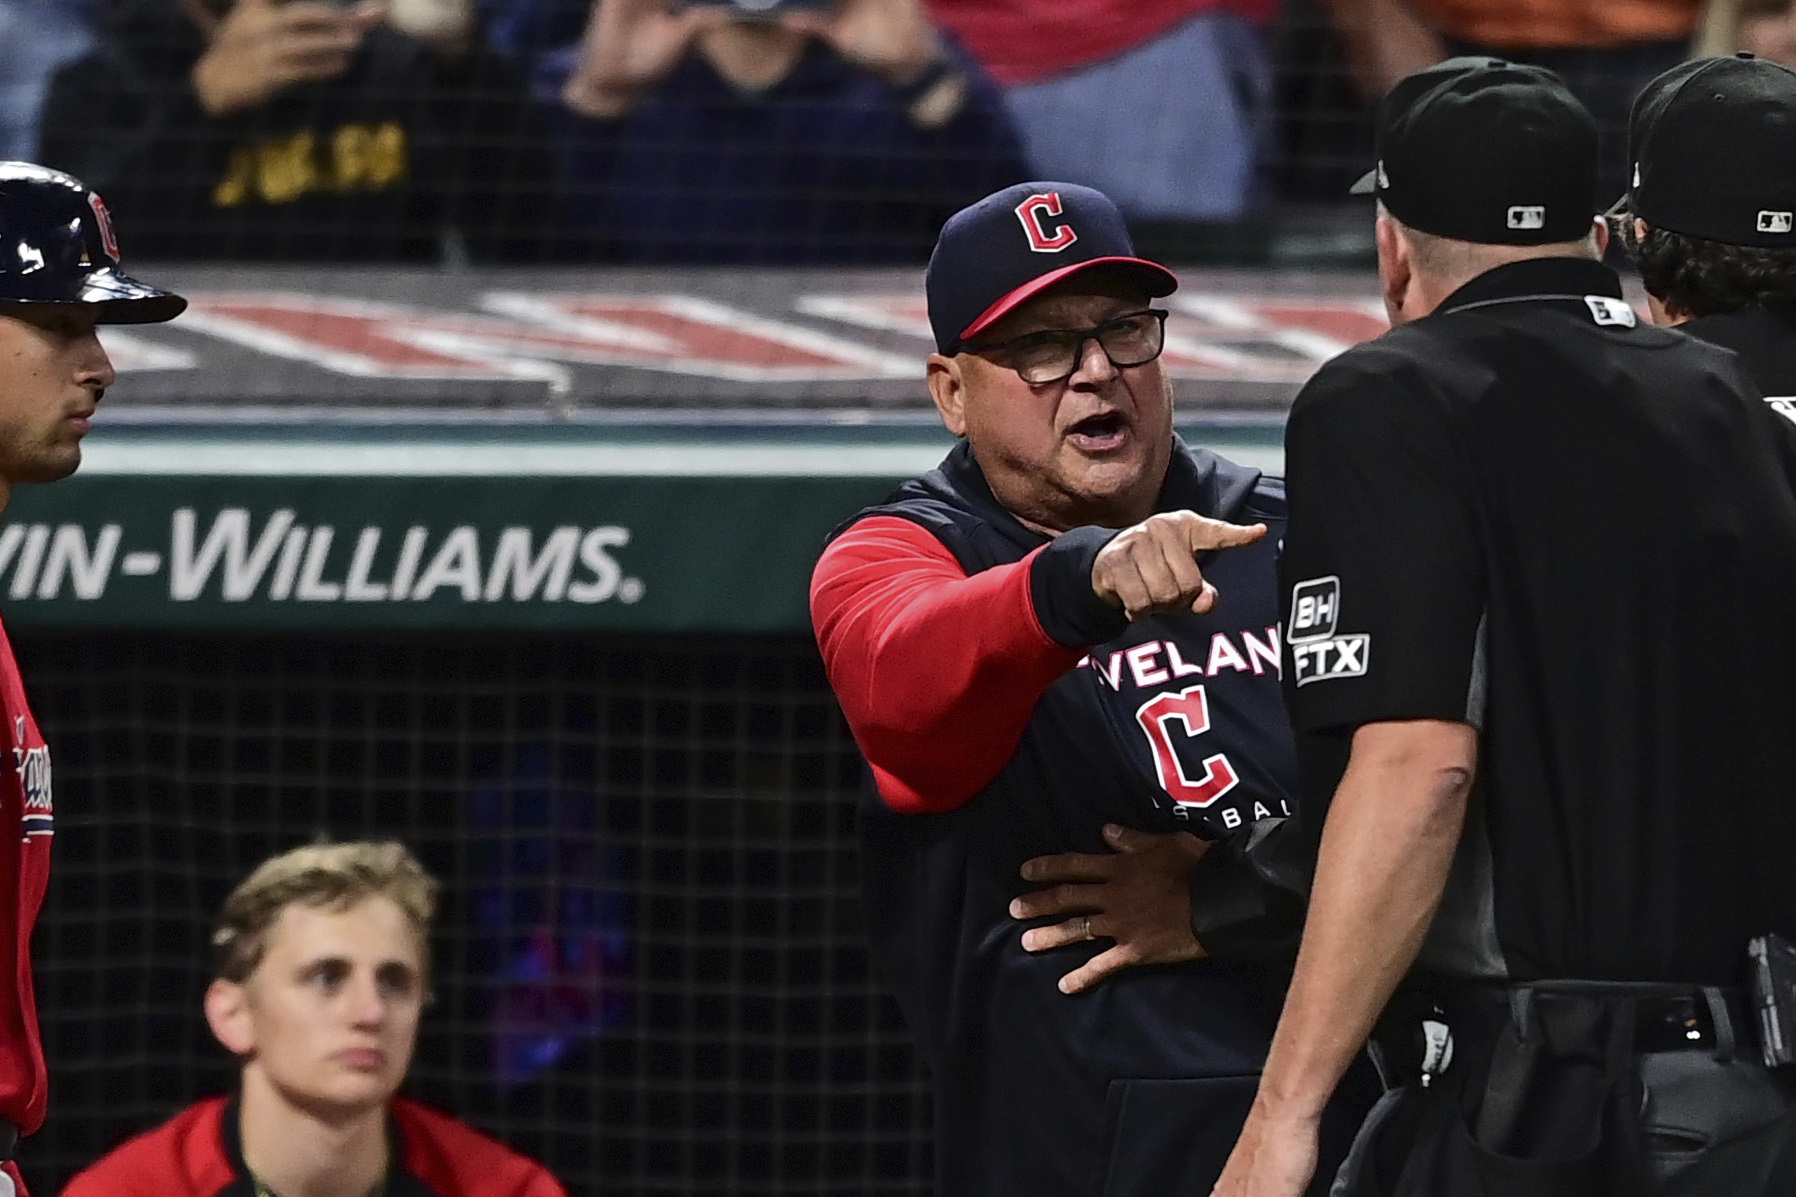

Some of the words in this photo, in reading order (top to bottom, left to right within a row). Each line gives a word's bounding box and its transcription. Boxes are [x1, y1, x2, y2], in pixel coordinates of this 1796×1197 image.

[1014, 191, 1078, 253] C
[1294, 592, 1335, 629] BH
[1294, 639, 1363, 681] FTX
[1135, 684, 1240, 808] C
